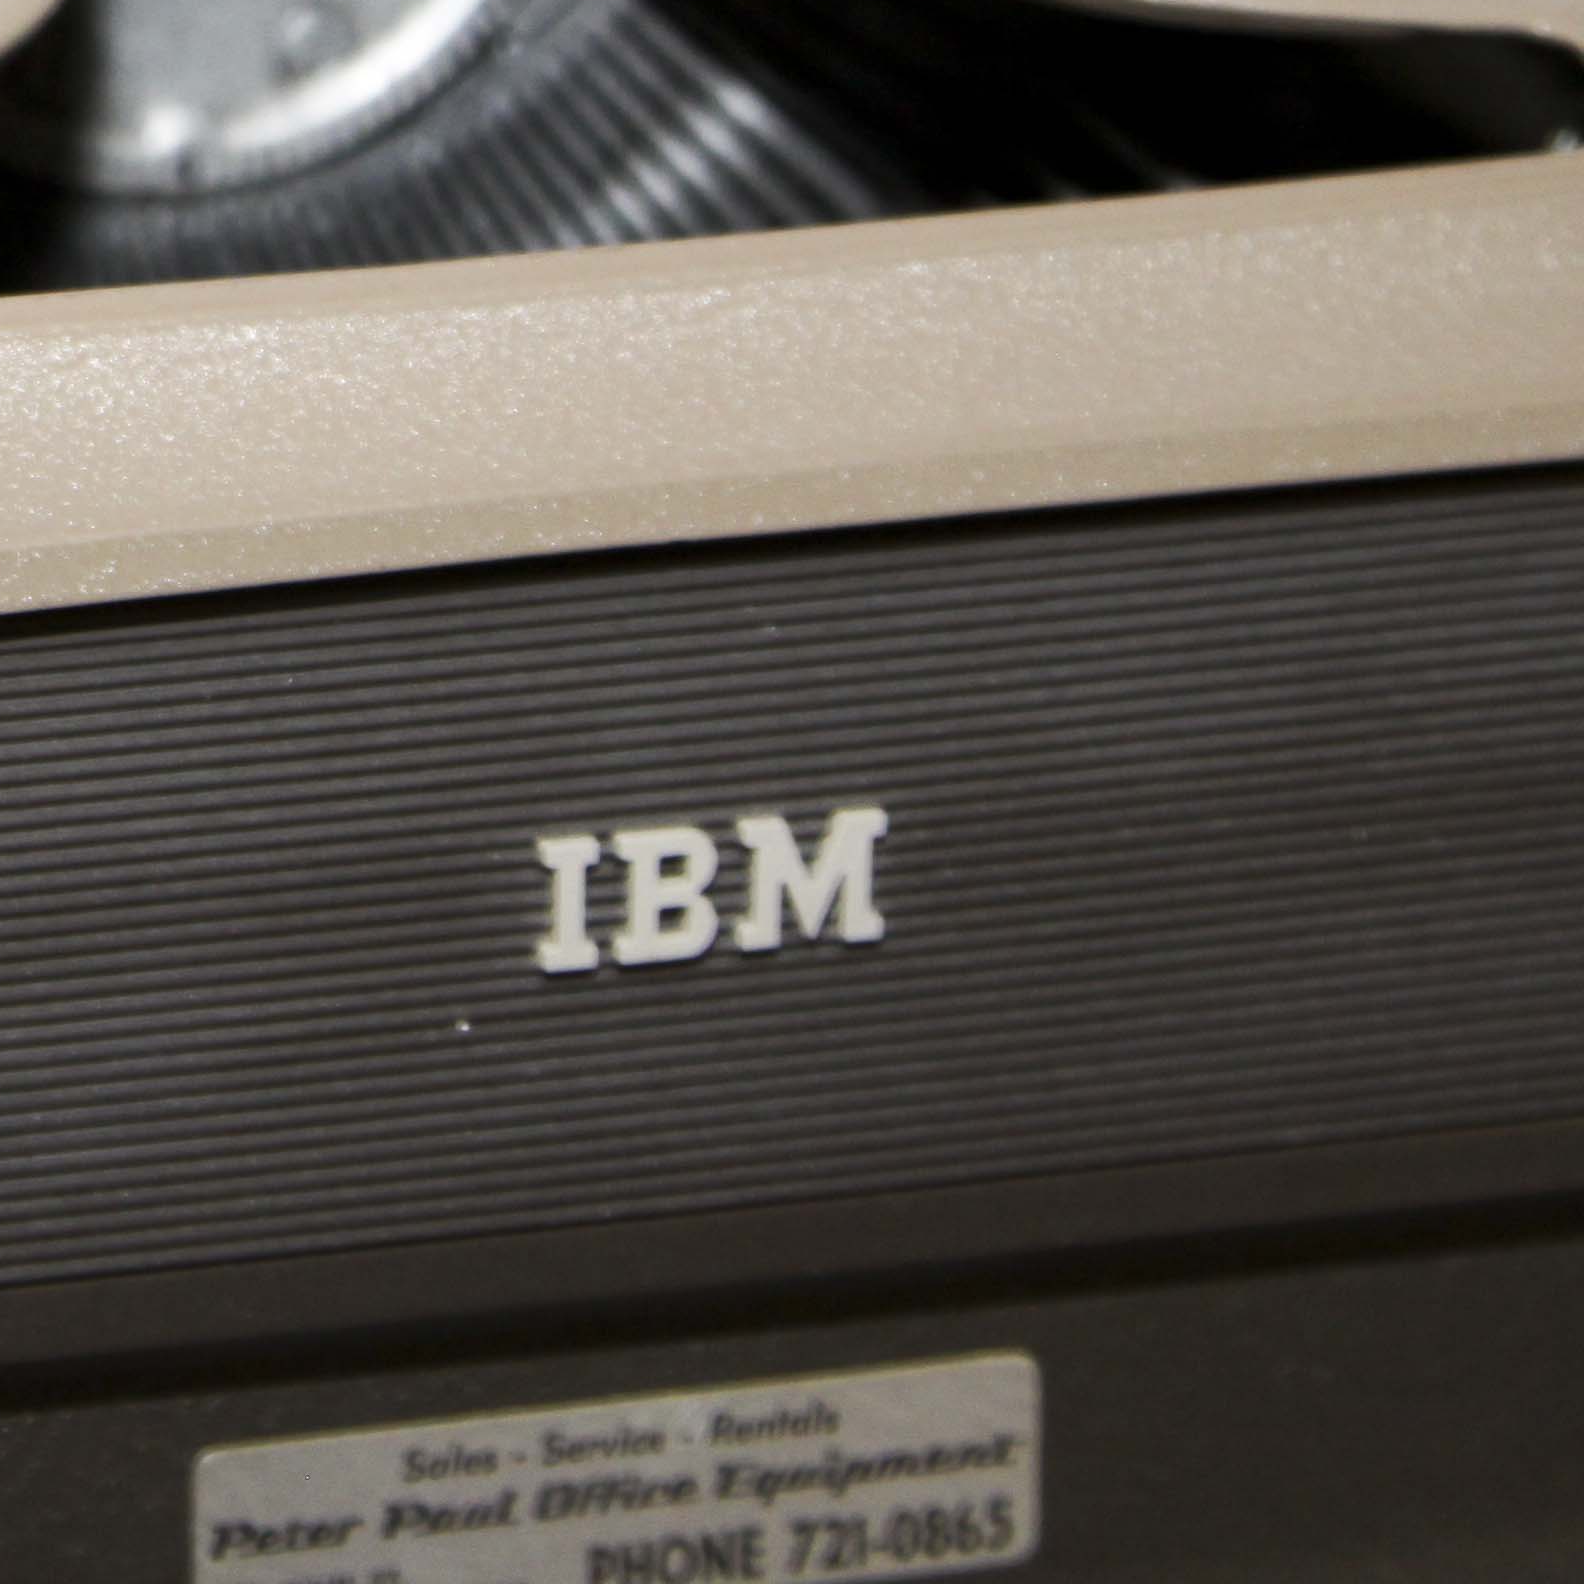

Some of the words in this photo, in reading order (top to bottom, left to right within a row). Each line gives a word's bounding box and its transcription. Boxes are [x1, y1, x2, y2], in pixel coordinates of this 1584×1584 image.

[536, 805, 889, 975] IBM
[209, 1513, 366, 1562] Peter
[536, 1472, 700, 1521] Office
[716, 1430, 1022, 1508] Equipment
[400, 1441, 498, 1483] Sales
[540, 1424, 667, 1466] Service
[709, 1399, 841, 1446] Rentals
[587, 1524, 766, 1584] PHONE
[787, 1490, 1016, 1576] 721-0865
